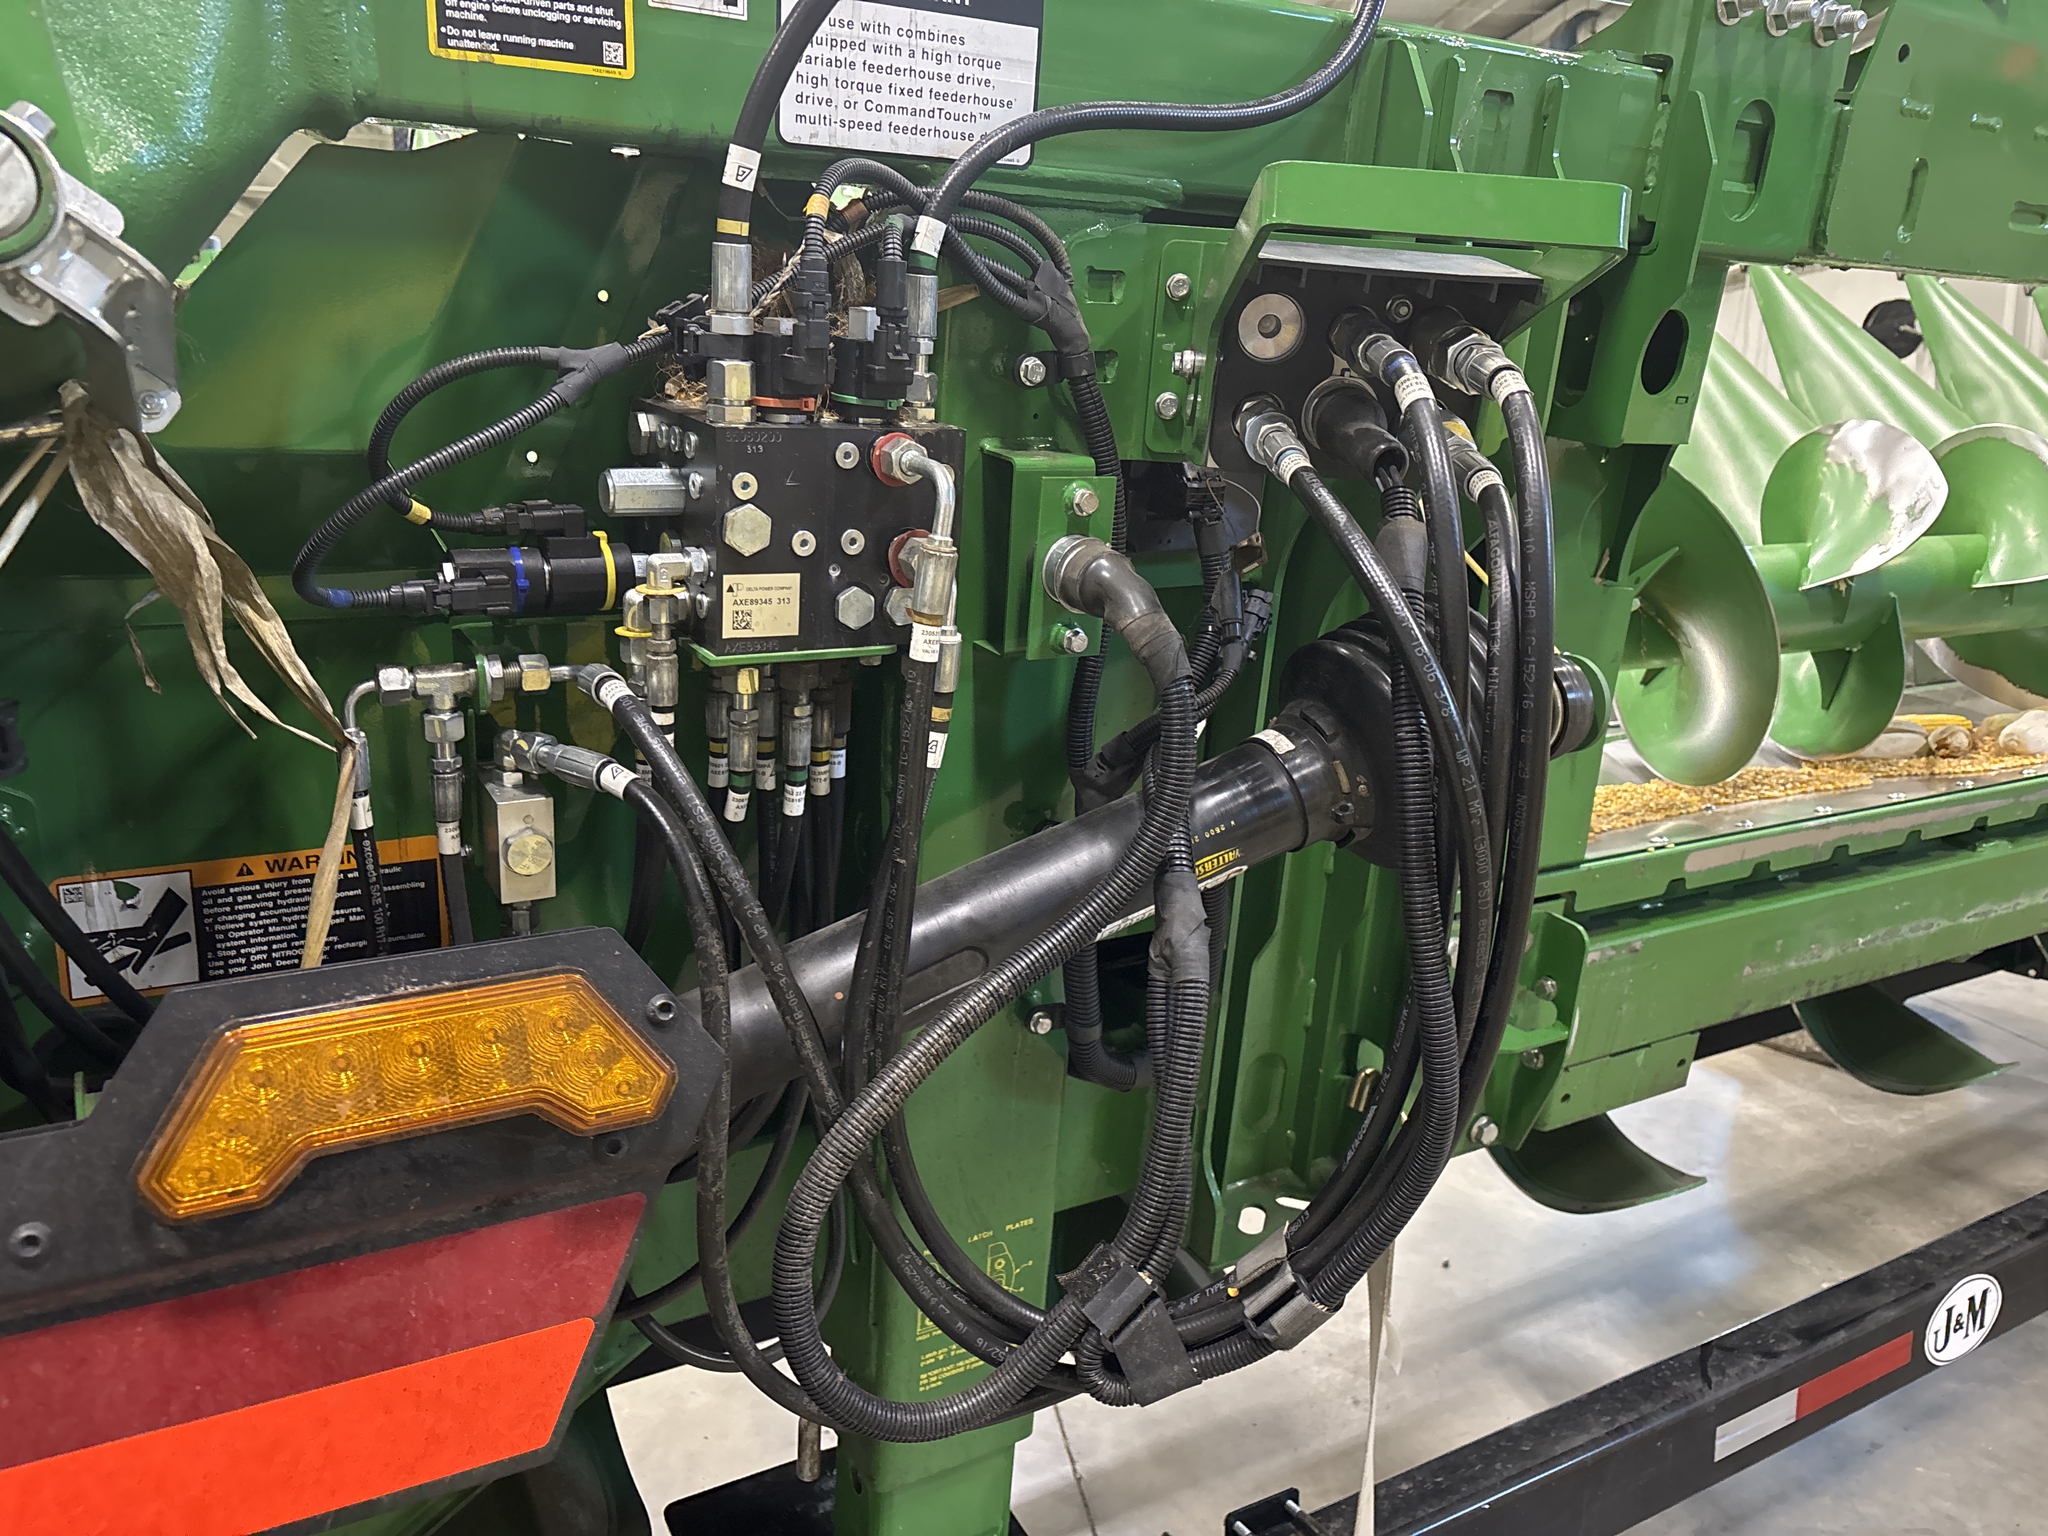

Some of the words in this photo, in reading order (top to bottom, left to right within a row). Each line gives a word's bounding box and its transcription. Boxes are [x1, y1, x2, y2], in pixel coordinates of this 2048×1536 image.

[445, 9, 488, 23] machine.
[459, 1, 490, 12] engine
[492, 3, 521, 15] before
[522, 8, 571, 24] unclogging
[572, 15, 582, 23] or
[583, 15, 622, 30] servicing
[553, 2, 575, 12] parts
[577, 4, 593, 13] and
[595, 6, 614, 16] shut
[461, 29, 477, 39] not
[478, 29, 502, 41] leave
[502, 34, 536, 48] running
[538, 38, 575, 50] machine
[828, 16, 855, 30] use
[860, 19, 891, 36] with
[896, 26, 966, 46] combines
[872, 42, 902, 58] with
[907, 48, 917, 59] a
[921, 47, 952, 65] high
[957, 53, 1002, 71] torque
[862, 60, 952, 83] feederhouse
[956, 73, 996, 91] drive,
[795, 71, 829, 89] high
[834, 76, 883, 95] torque
[887, 82, 923, 98] fixed
[929, 87, 1013, 110] feederhouse
[795, 91, 839, 111] drive,
[843, 99, 859, 110] or
[795, 113, 882, 132] multi-speed
[888, 121, 976, 142] feederhouse
[732, 598, 773, 606] AXE89345
[776, 597, 791, 605] 313
[632, 712, 653, 735] SAE
[651, 736, 687, 786] exceeds
[361, 839, 379, 883] exceeds
[201, 887, 226, 897] Avoid
[229, 884, 261, 894] serious
[264, 880, 288, 890] injury
[291, 878, 311, 887] from
[216, 896, 233, 905] and
[236, 894, 253, 903] gas
[256, 890, 281, 899] under
[202, 905, 232, 916] Before
[234, 900, 274, 911] removing
[217, 912, 256, 923] changing
[214, 922, 246, 932] Relieve
[248, 917, 279, 927] system
[214, 932, 225, 940] to
[227, 928, 265, 939] Operator
[268, 923, 298, 934] Manual
[216, 940, 247, 950] system
[249, 931, 299, 944] information.
[216, 948, 237, 959] Stop
[240, 945, 269, 955] engine
[271, 941, 288, 950] and
[1475, 918, 1488, 968] exceeds
[207, 960, 225, 968] Use
[227, 956, 247, 967] only
[249, 953, 269, 962] DRY
[208, 968, 225, 977] See
[228, 965, 248, 975] your
[250, 962, 273, 971] John
[275, 958, 299, 968] Deere
[1005, 1217, 1034, 1232] PLATES
[967, 1229, 994, 1244] LATCH
[1204, 1279, 1227, 1298] TYPE
[1934, 1287, 1990, 1354] J&M
